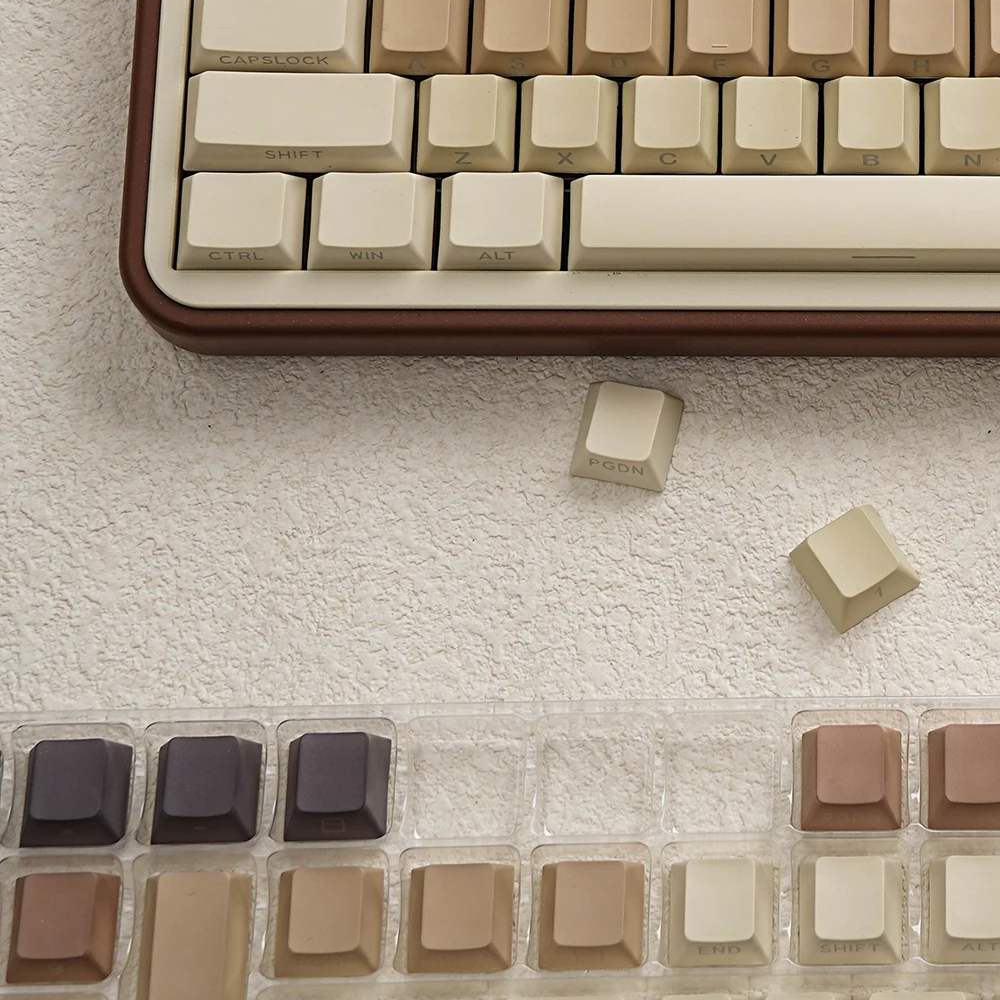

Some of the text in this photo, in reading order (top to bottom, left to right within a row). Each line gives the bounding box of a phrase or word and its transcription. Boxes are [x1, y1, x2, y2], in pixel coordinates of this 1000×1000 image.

[219, 54, 329, 67] CAPSLOCK
[406, 56, 427, 70] A
[509, 57, 526, 72] S
[610, 57, 629, 71] D
[712, 57, 728, 73] F
[811, 59, 831, 74] G
[912, 59, 931, 74] H
[264, 149, 324, 160] SHIFT
[454, 151, 473, 166] Z
[556, 151, 575, 166] X
[658, 152, 678, 167] C
[758, 153, 778, 168] V
[861, 153, 881, 168] B
[963, 154, 982, 167] N
[207, 251, 265, 262] CTRL
[348, 250, 384, 261] WIN
[478, 250, 516, 261] ALT
[588, 457, 645, 477] PGDN
[697, 944, 742, 956] END
[820, 942, 882, 954] SHIFT
[961, 941, 999, 952] ALT
